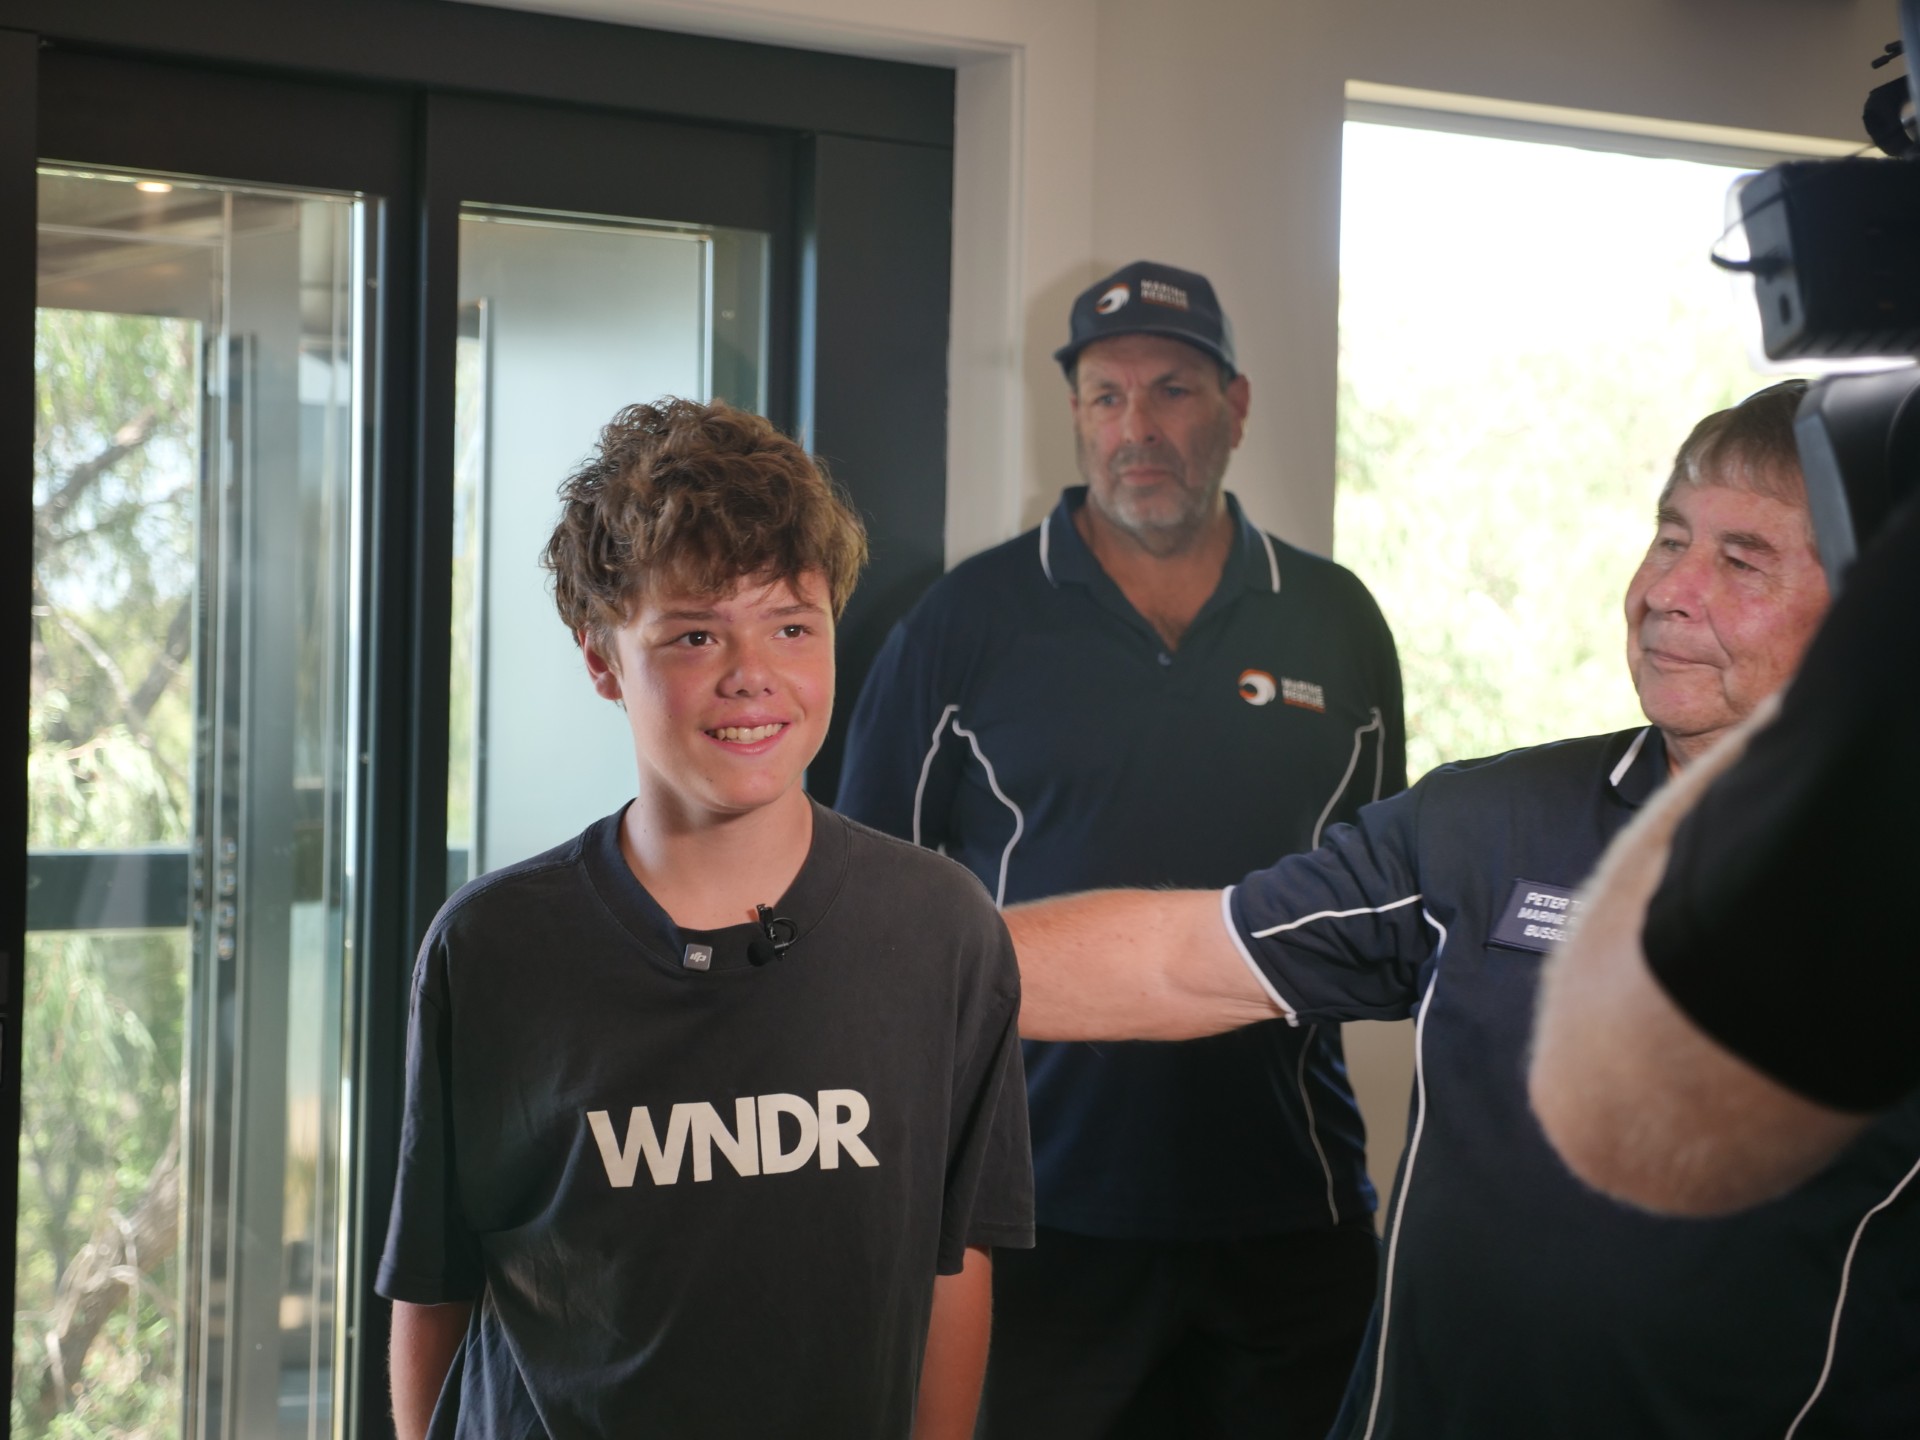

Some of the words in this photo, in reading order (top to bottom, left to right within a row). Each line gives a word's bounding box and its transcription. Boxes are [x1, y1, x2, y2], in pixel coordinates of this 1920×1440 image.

[1524, 892, 1570, 910] PETER
[1517, 907, 1568, 925] MARINE
[1523, 924, 1570, 942] BUSSE
[587, 1089, 880, 1187] WNDR
